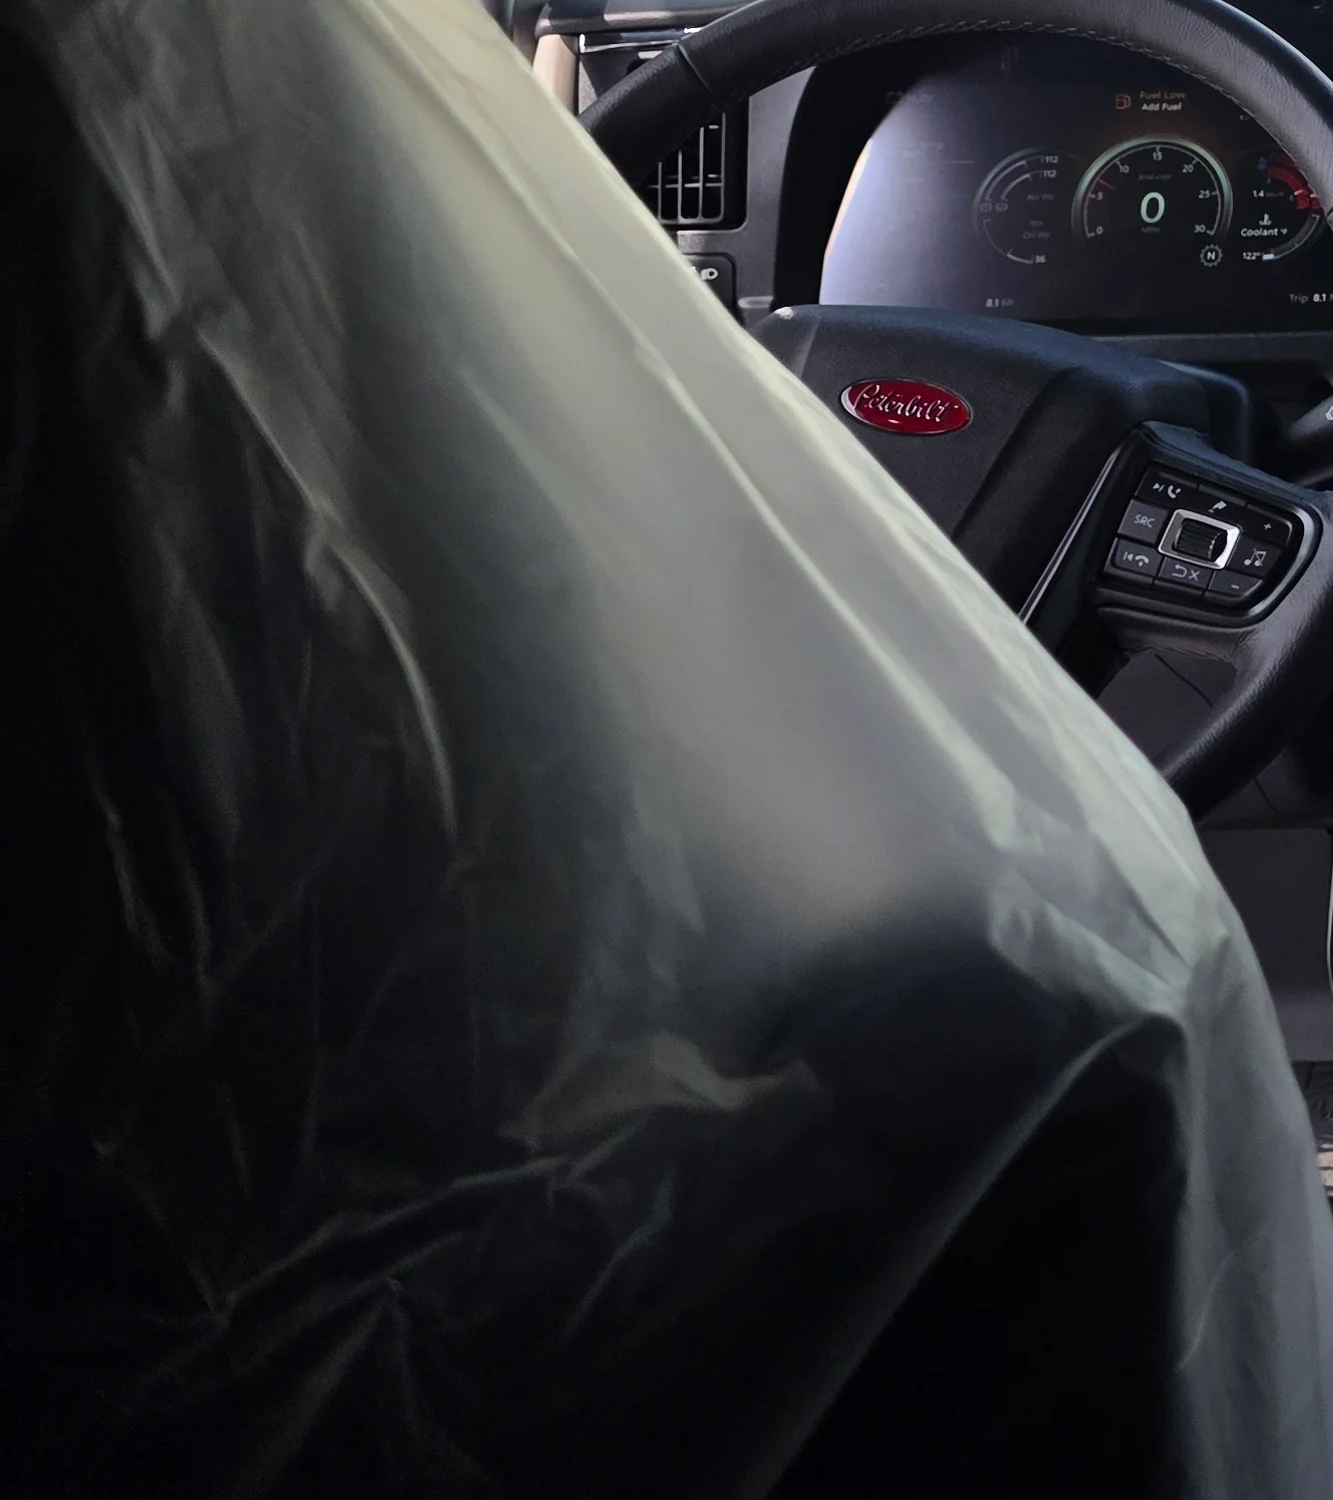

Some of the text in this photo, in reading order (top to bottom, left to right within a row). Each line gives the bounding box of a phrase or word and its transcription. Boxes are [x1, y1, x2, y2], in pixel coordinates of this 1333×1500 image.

[1162, 102, 1182, 112] Fuel
[1182, 164, 1194, 174] 20
[1140, 191, 1166, 224] 0
[1240, 227, 1278, 237] Coolant
[1206, 251, 1216, 261] N
[854, 383, 958, 424] Peterbilt
[1134, 513, 1156, 530] SRC
